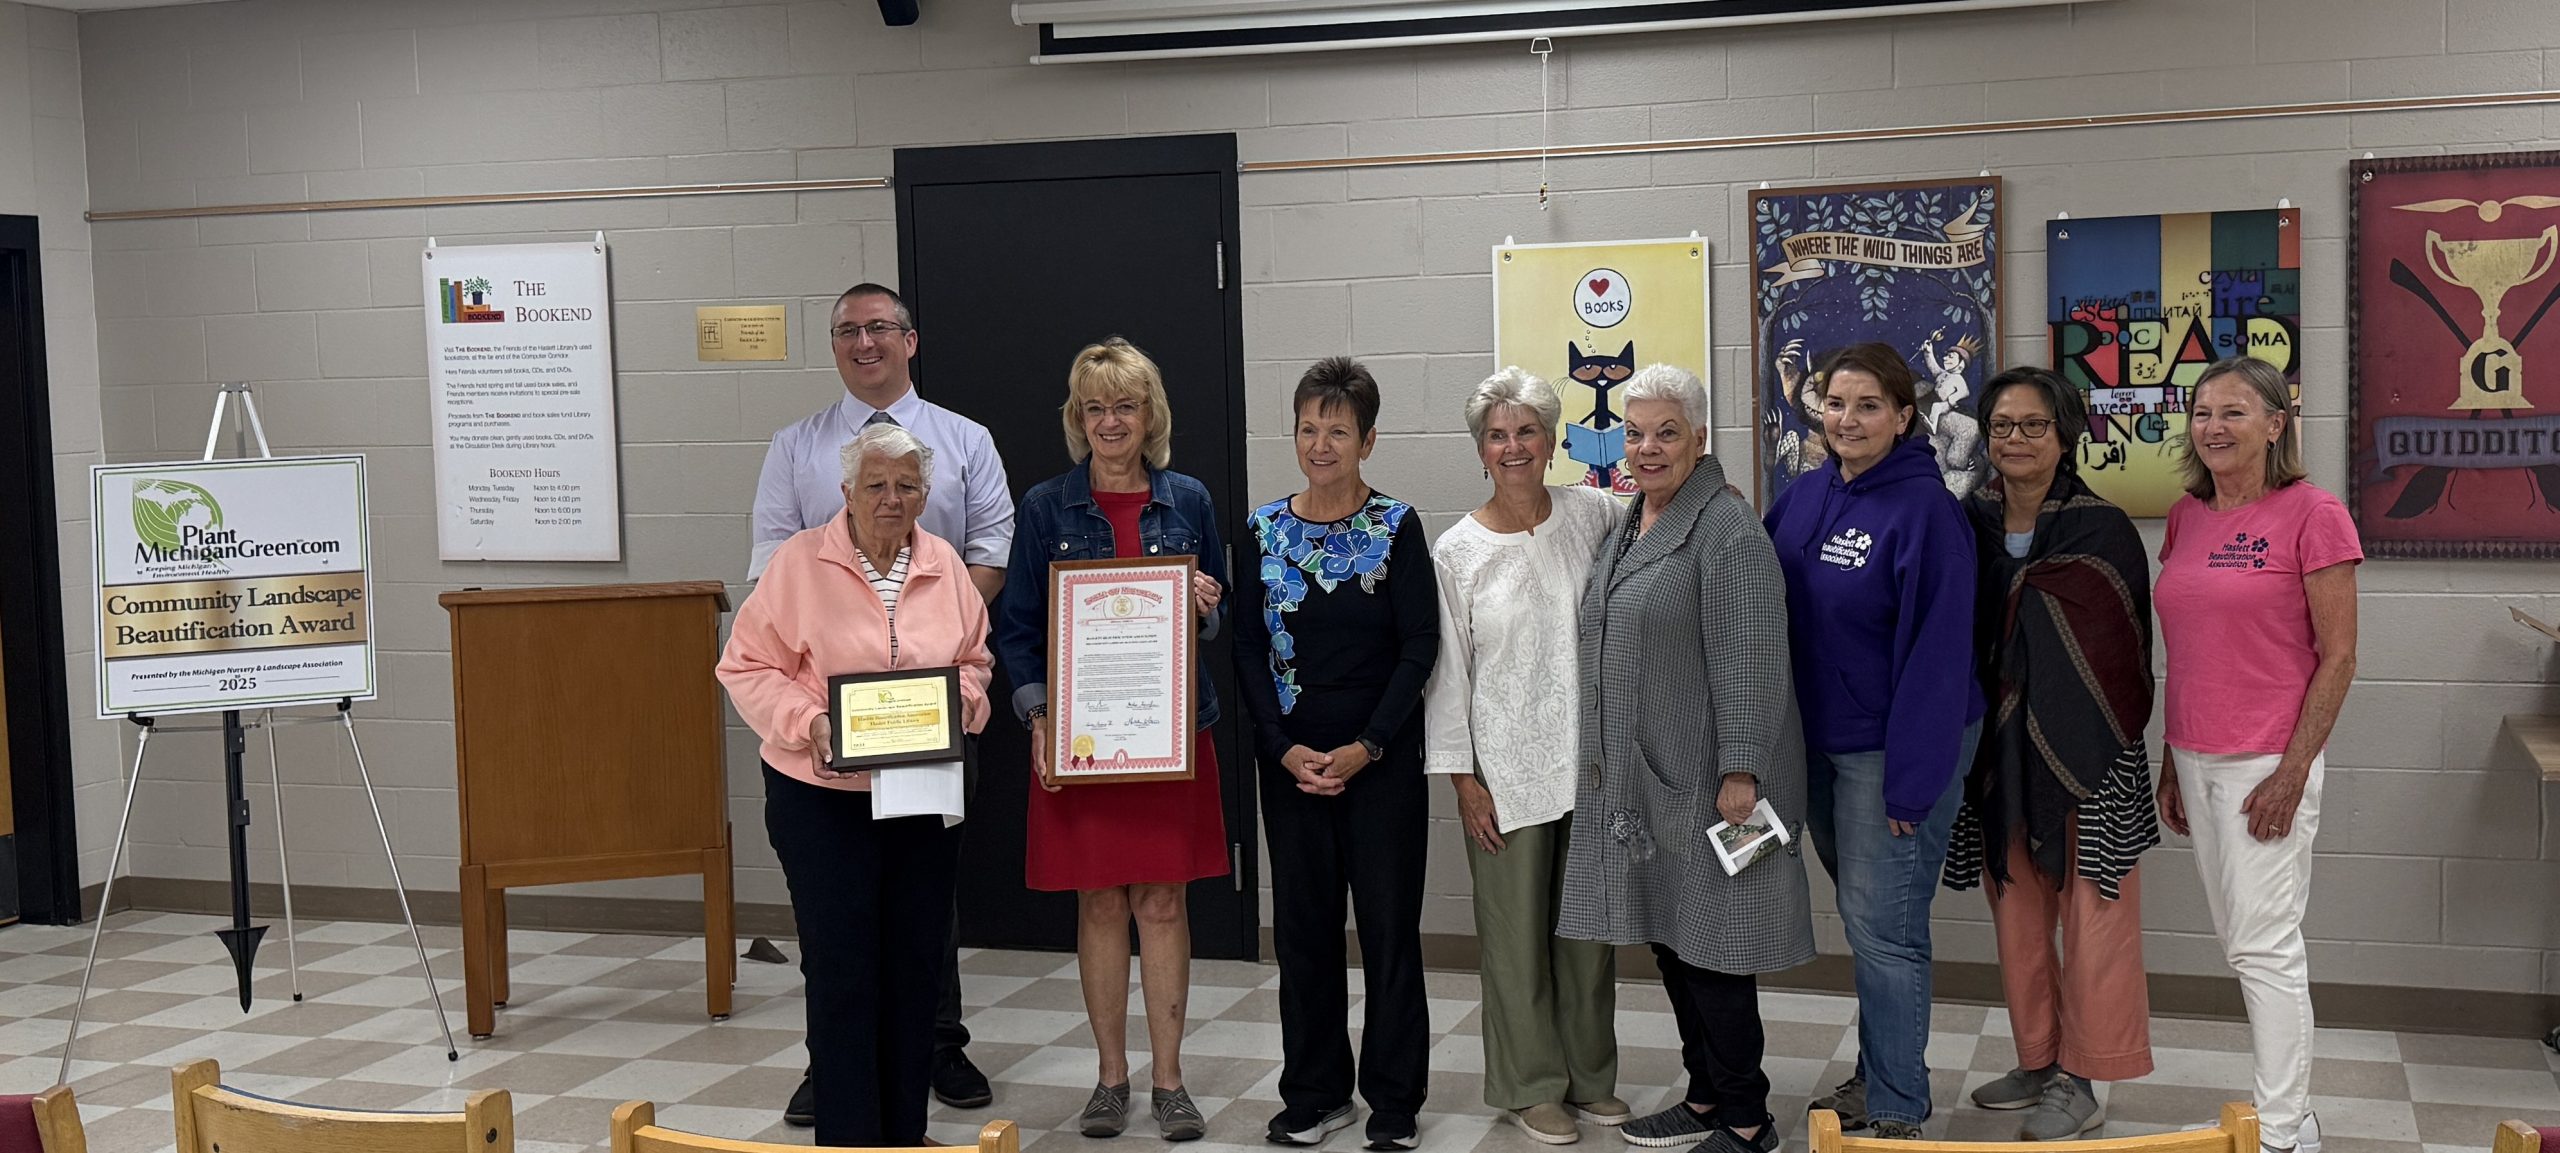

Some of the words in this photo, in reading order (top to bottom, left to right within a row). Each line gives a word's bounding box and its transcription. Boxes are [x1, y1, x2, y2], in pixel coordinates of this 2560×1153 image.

[1787, 236, 1831, 258] WHERE
[1834, 236, 1859, 256] THE
[1863, 238, 1896, 261] WILD
[1901, 243, 1952, 265] THINGS
[1957, 240, 1982, 263] ARE
[514, 280, 545, 296] THE
[516, 307, 592, 322] BOOKEND
[1585, 300, 1624, 314] BOOKS
[2218, 332, 2288, 348] SOMA
[2048, 315, 2298, 388] READ
[2471, 348, 2510, 393] G
[490, 468, 532, 478] BOOKEND
[535, 468, 560, 478] Hours
[470, 518, 494, 526] Saturday
[183, 525, 237, 546] Plant
[1831, 534, 1856, 548] Haslett
[2223, 544, 2250, 552] Haslett
[2208, 552, 2256, 561] Beautification
[2206, 560, 2248, 569] Association
[202, 569, 230, 577] Healthy
[107, 590, 242, 615] Community
[247, 585, 362, 607] Landscape
[116, 619, 273, 645] Beautification
[280, 612, 355, 635] Award
[131, 671, 167, 681] Presented
[169, 671, 178, 679] by
[192, 668, 225, 676] Michigan
[227, 666, 255, 675] Nursery
[263, 663, 301, 672] Landscape
[302, 660, 343, 669] Association
[219, 677, 256, 691] 2025
